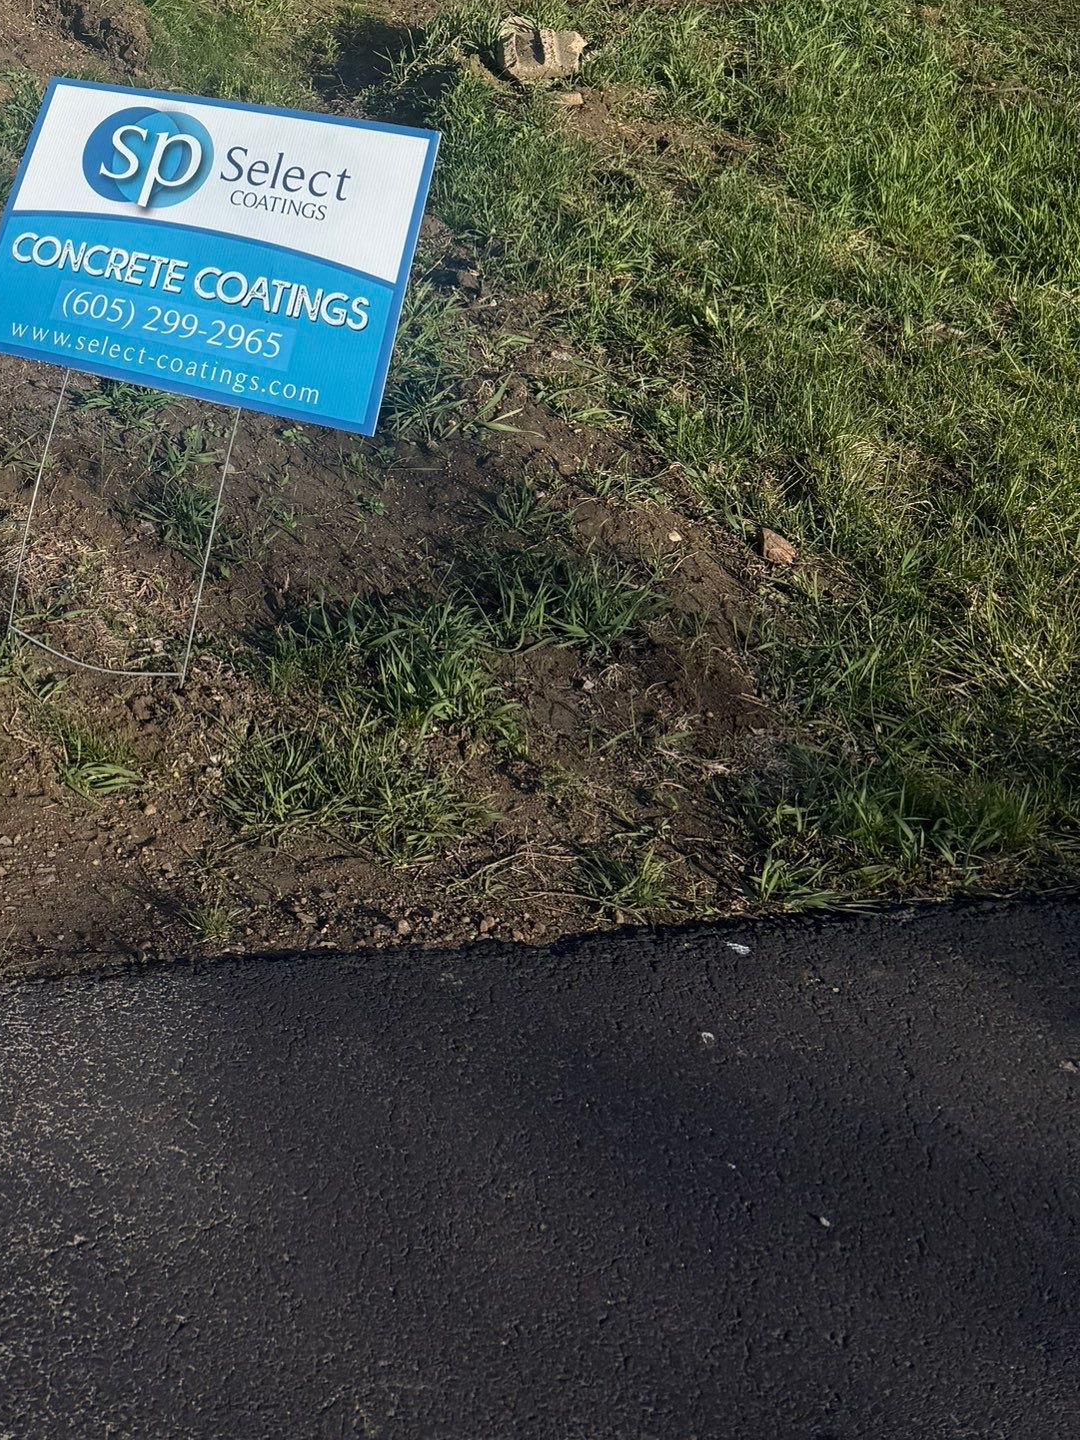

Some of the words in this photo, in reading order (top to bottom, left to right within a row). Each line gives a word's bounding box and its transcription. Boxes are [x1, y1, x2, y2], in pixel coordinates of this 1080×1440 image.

[99, 124, 203, 208] sp
[220, 145, 352, 201] Select
[230, 189, 328, 221] COATINGS
[11, 232, 189, 294] CONCRETE
[194, 266, 370, 331] COATINGS
[62, 288, 136, 329] (605)
[143, 306, 283, 359] 299-2965
[11, 321, 320, 404] www.select-coatings.com
